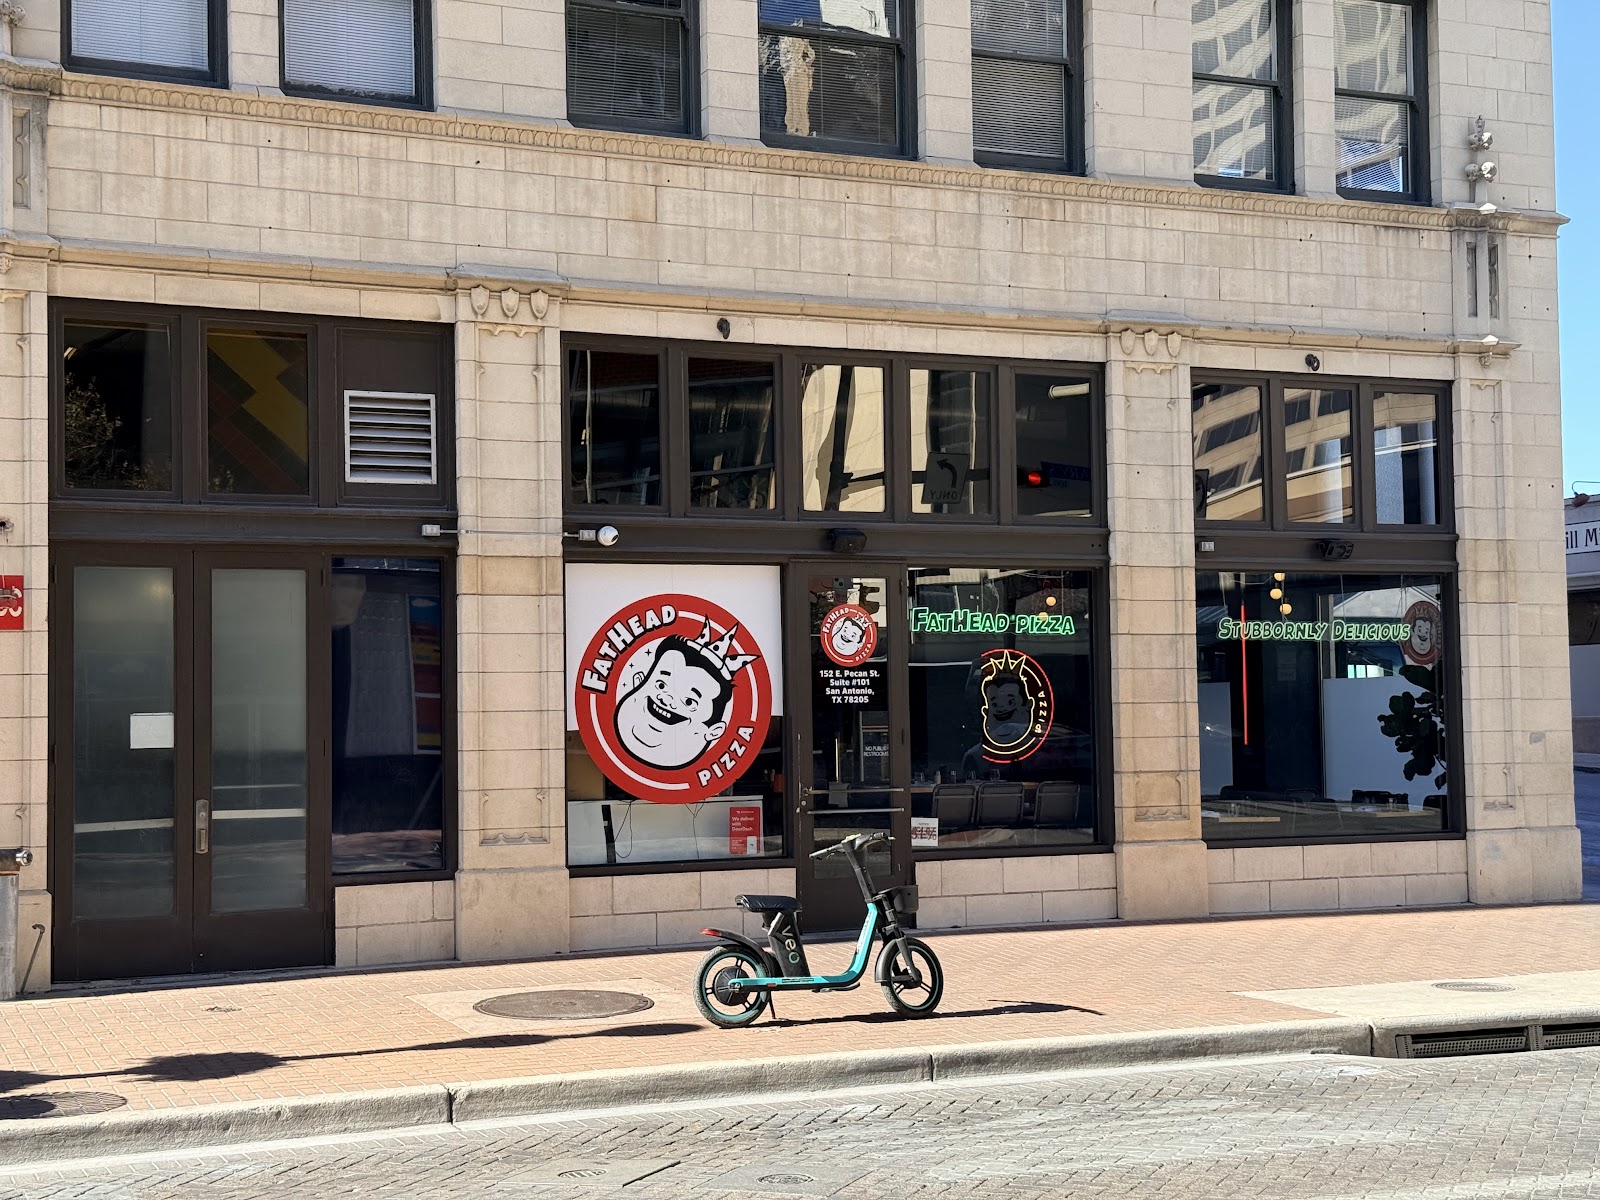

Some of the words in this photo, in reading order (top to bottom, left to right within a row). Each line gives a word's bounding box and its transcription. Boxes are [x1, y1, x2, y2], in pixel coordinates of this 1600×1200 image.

[1584, 527, 1600, 547] M
[822, 607, 850, 633] FATHEAD
[911, 606, 1010, 633] FATHEAD
[1015, 614, 1075, 635] PIZZA
[1217, 616, 1328, 641] STUBBORNLY
[1331, 619, 1411, 642] DELICIOUS
[582, 604, 677, 694] FATHEAD
[855, 643, 872, 662] PIZZA
[819, 669, 834, 678] 152
[835, 669, 843, 678] E.
[844, 669, 868, 678] Pecan
[869, 669, 880, 678] St.
[829, 678, 850, 686] Suite
[851, 678, 870, 686] #101
[825, 687, 840, 695] San
[841, 687, 875, 696] Antonio,
[831, 695, 843, 704] TX
[844, 695, 869, 704] 78205
[1034, 690, 1048, 734] PIZZA
[697, 725, 755, 787] PIZZA
[781, 924, 800, 964] veo
